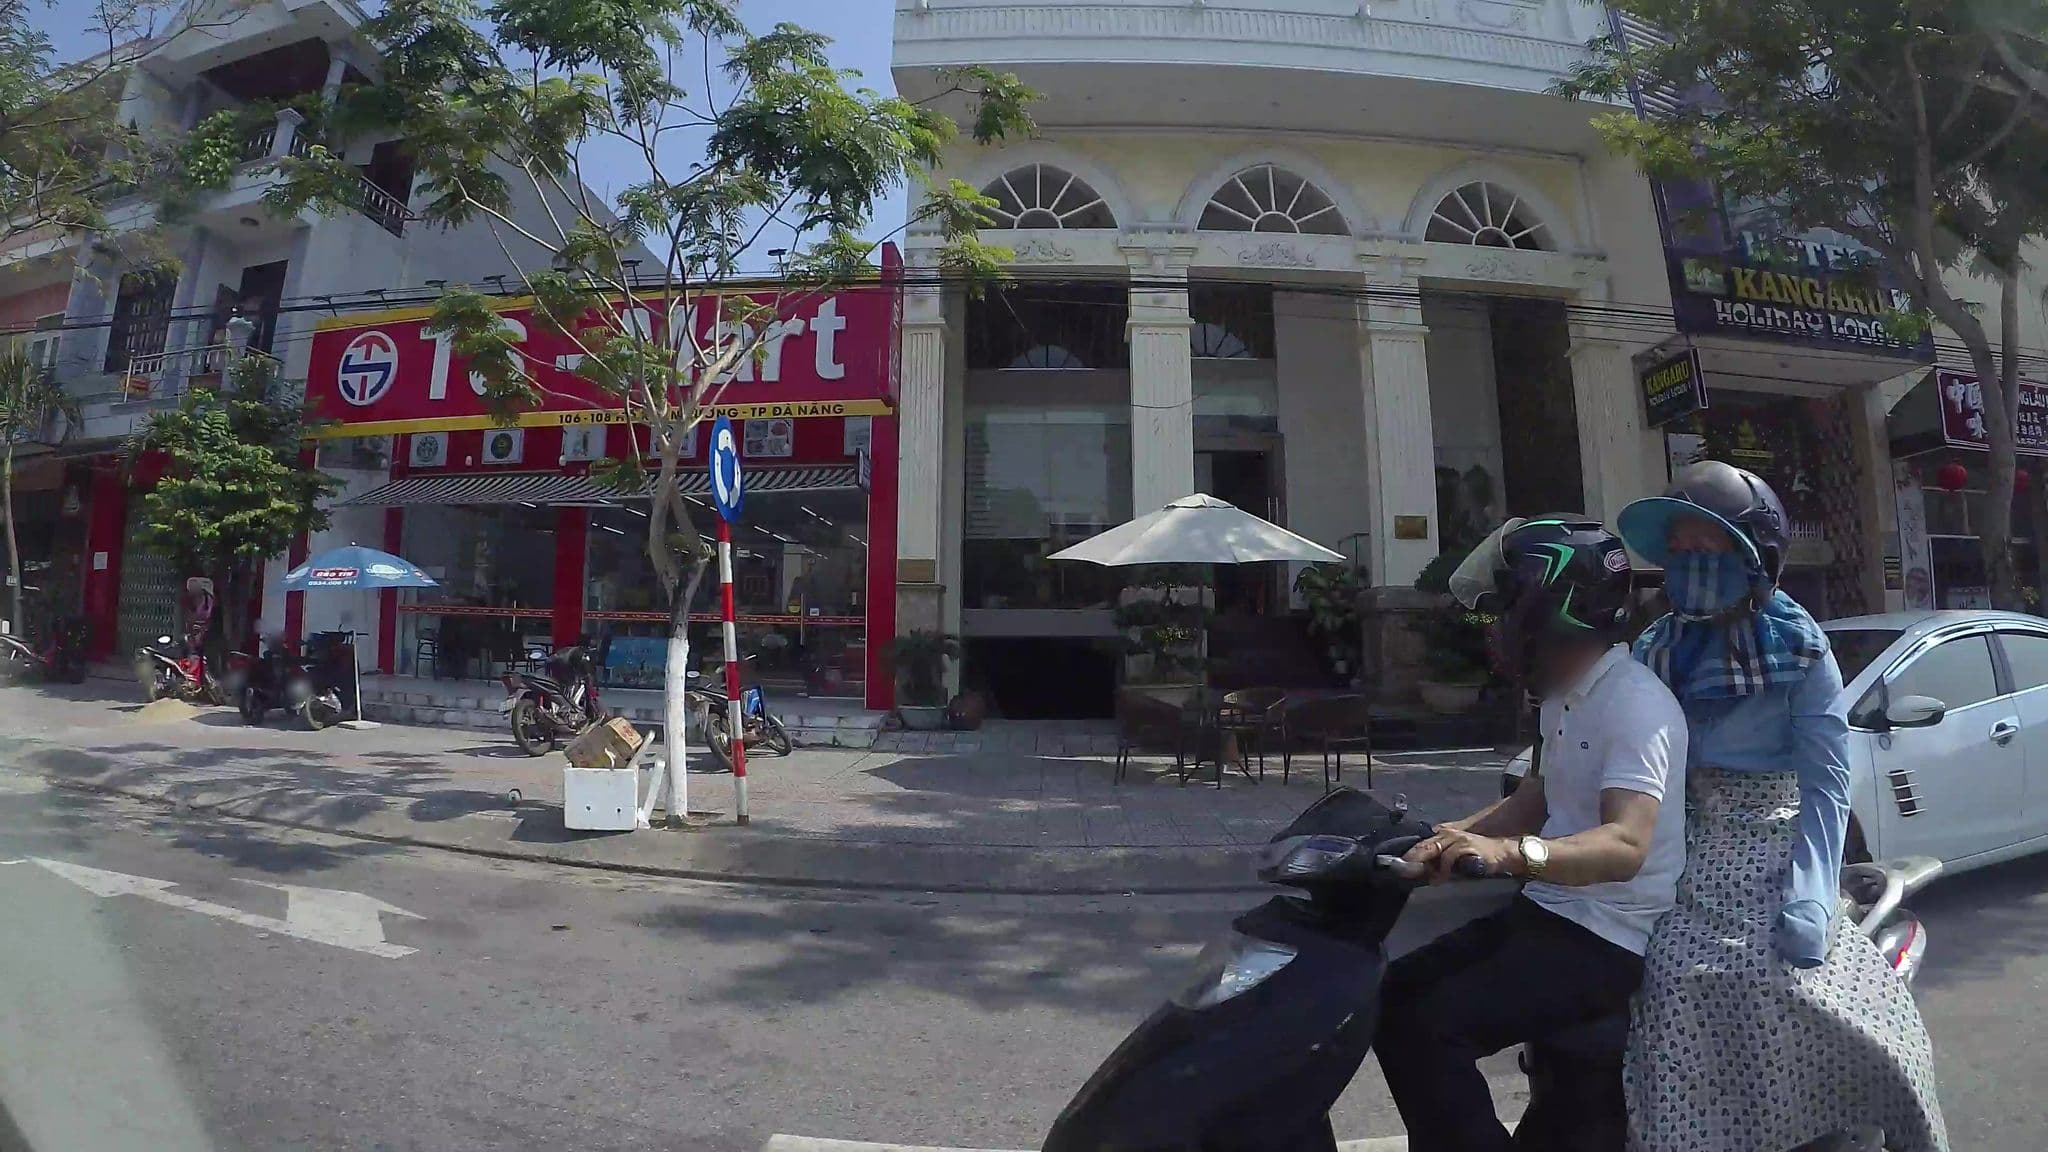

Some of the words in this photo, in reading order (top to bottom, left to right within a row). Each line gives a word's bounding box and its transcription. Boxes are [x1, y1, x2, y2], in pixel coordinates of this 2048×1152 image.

[1713, 298, 1824, 336] HOLIDAY
[1646, 360, 1689, 396] KANGARU
[751, 407, 767, 417] TP
[772, 404, 793, 416] ĐÀ
